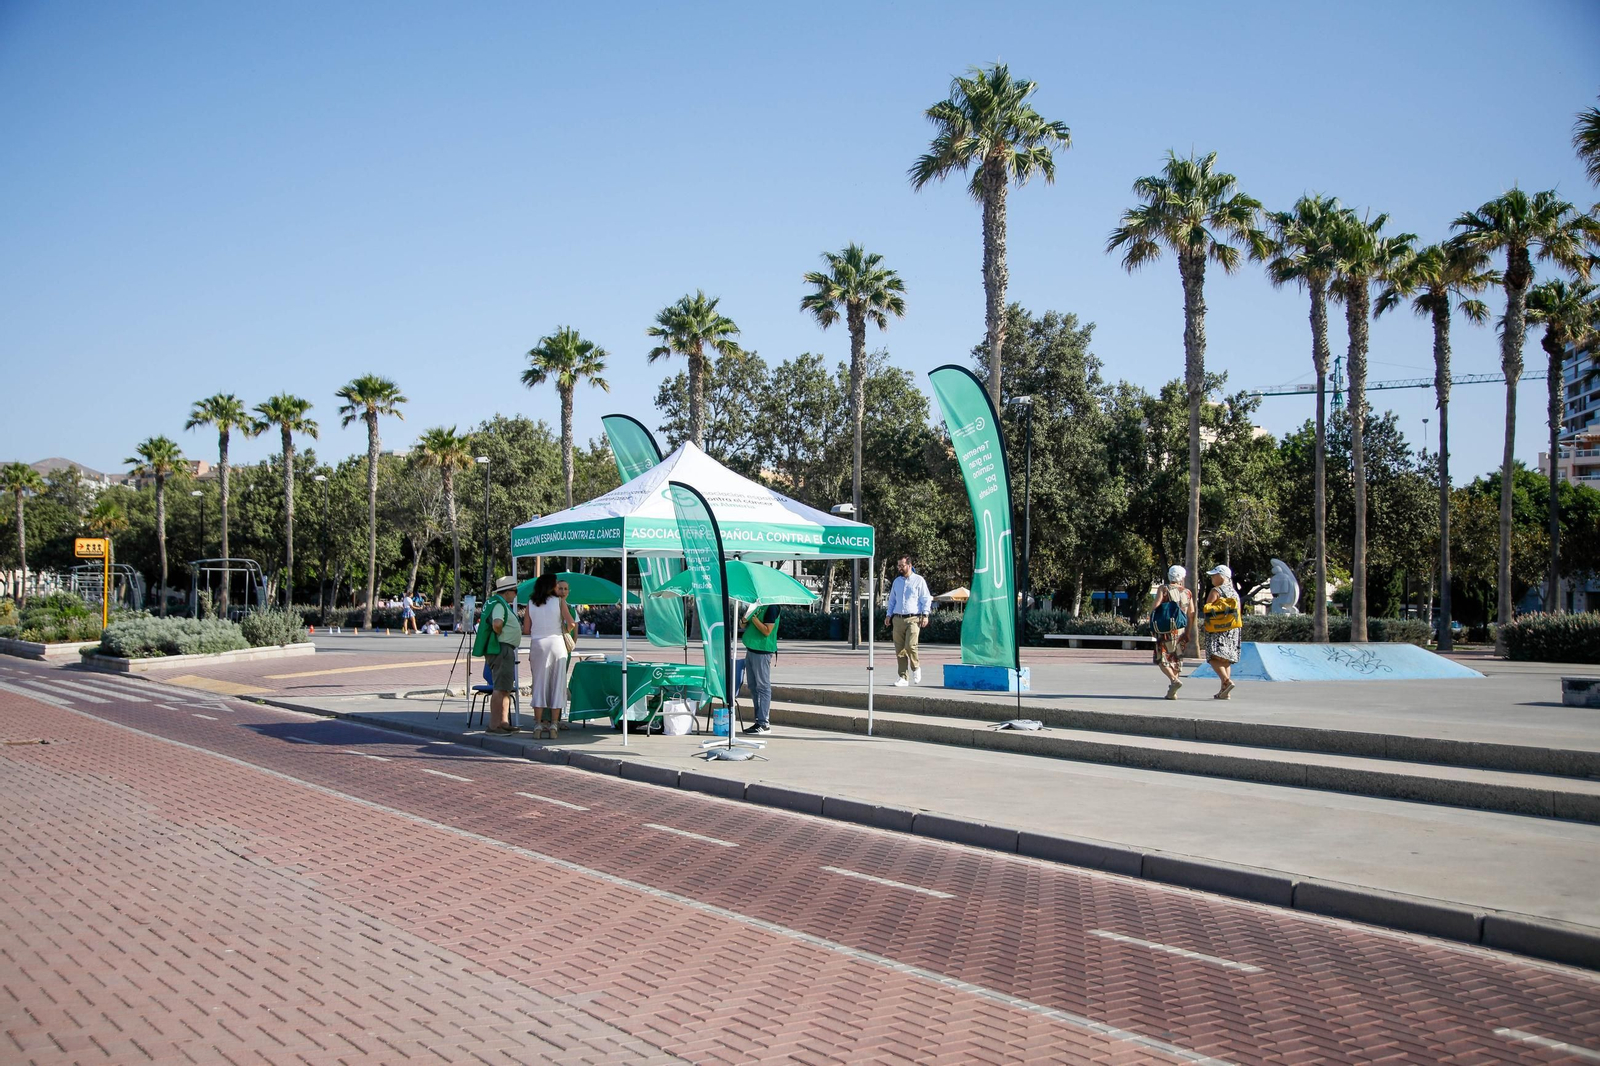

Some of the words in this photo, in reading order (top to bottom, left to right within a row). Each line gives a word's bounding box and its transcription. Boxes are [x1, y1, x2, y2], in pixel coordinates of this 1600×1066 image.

[541, 529, 567, 543] ESPAÑOLA
[567, 529, 588, 540] CONTRA
[588, 529, 596, 539] EL
[597, 526, 621, 539] CÁNCER
[766, 531, 812, 543] CONTRA
[813, 534, 826, 545] EL
[827, 533, 870, 547] CÁNCER
